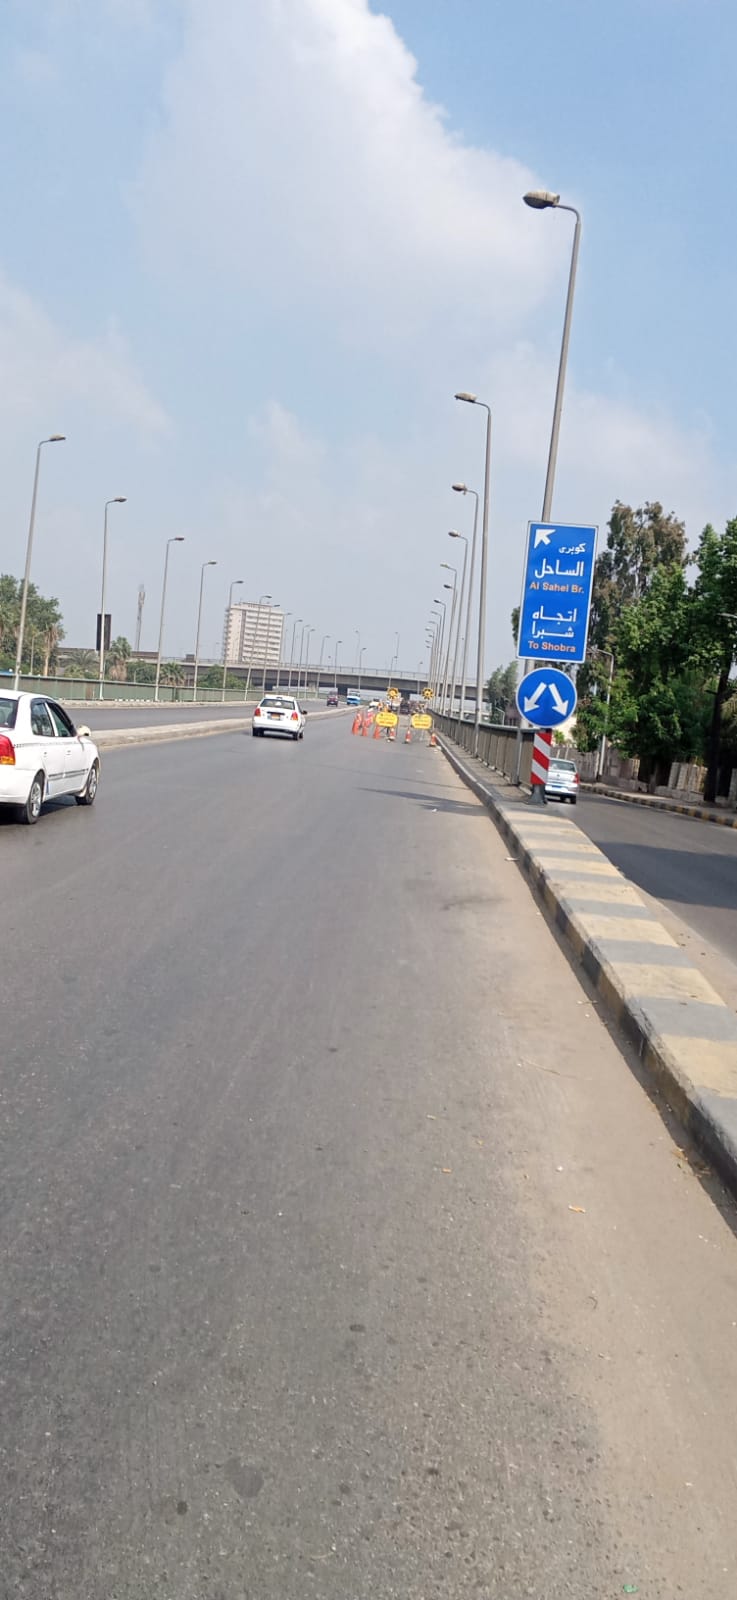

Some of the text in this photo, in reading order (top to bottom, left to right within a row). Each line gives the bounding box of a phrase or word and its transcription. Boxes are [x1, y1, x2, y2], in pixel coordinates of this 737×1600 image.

[535, 558, 584, 578] الساحل
[530, 582, 584, 593] Al Sahel Br.
[532, 605, 577, 625] اتجاه
[531, 621, 574, 639] شبرا
[528, 641, 576, 652] To Shobra
